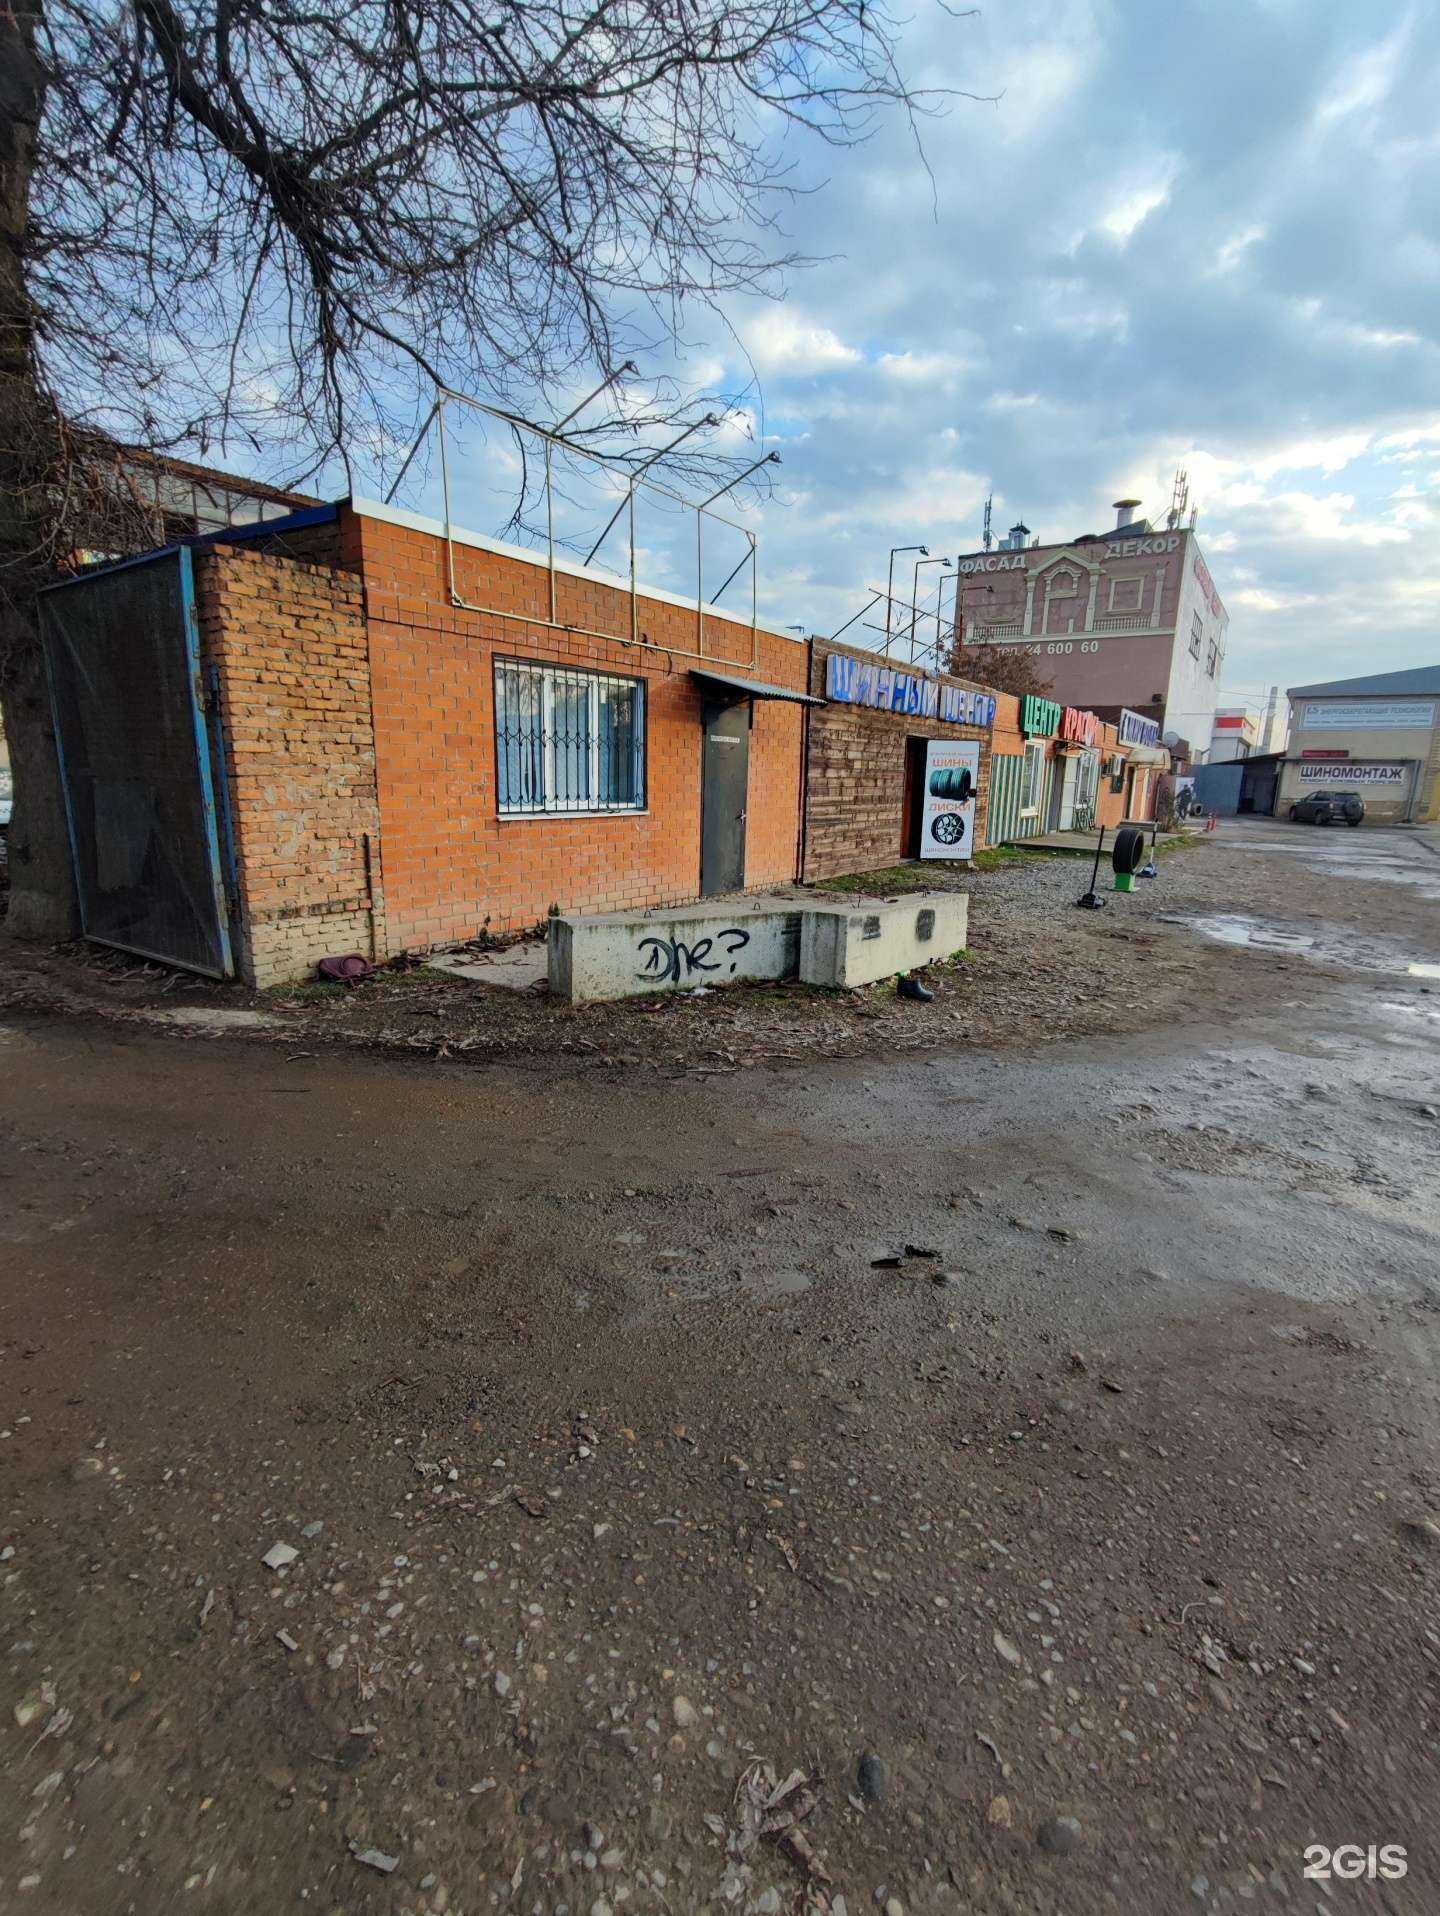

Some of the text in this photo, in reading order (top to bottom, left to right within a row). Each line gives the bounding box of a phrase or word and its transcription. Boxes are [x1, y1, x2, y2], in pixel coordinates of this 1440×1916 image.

[960, 537, 1181, 573] ФАСАД ДЕКОР
[1047, 642, 1073, 655] 600
[1080, 640, 1099, 653] 60
[940, 685, 997, 728] ЦЕНТР
[1023, 694, 1061, 742] ЦЕНТР
[932, 758, 972, 767] ШИНЫ
[1301, 766, 1403, 779] ШИНОМОНТАЖ
[929, 801, 972, 812] ДИСКИ
